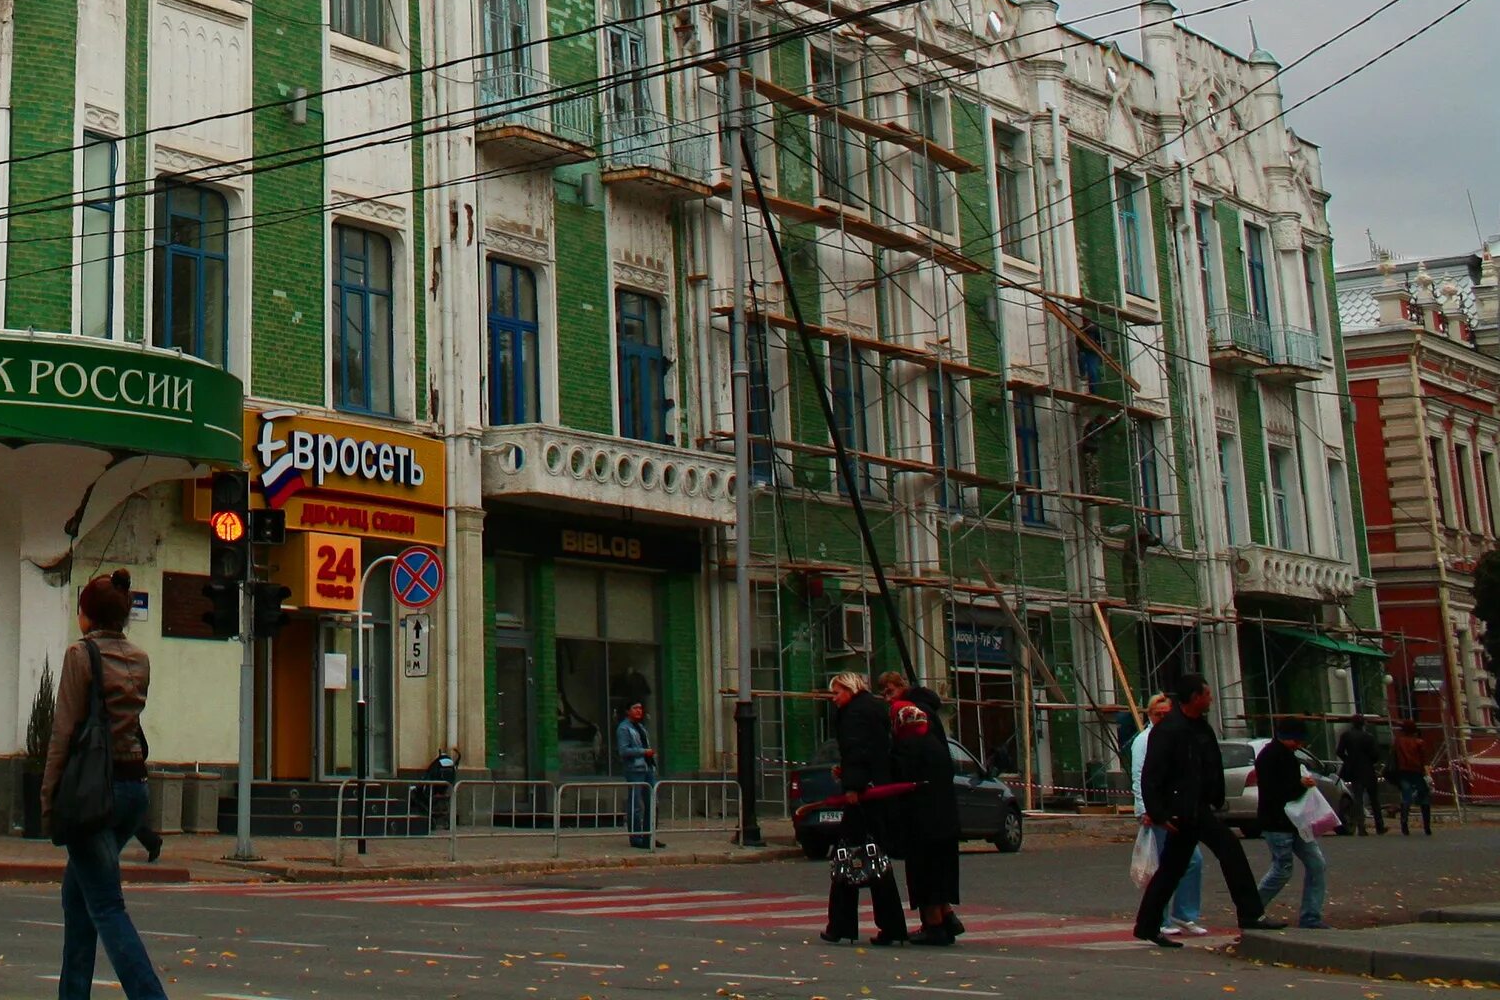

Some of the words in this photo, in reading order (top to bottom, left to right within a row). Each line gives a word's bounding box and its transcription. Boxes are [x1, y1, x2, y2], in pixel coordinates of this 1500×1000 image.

[28, 358, 193, 413] РОССИИ
[257, 408, 425, 487] Евросеть
[317, 544, 356, 583] 24
[562, 529, 642, 561] BIBLOS
[413, 642, 421, 658] 5
